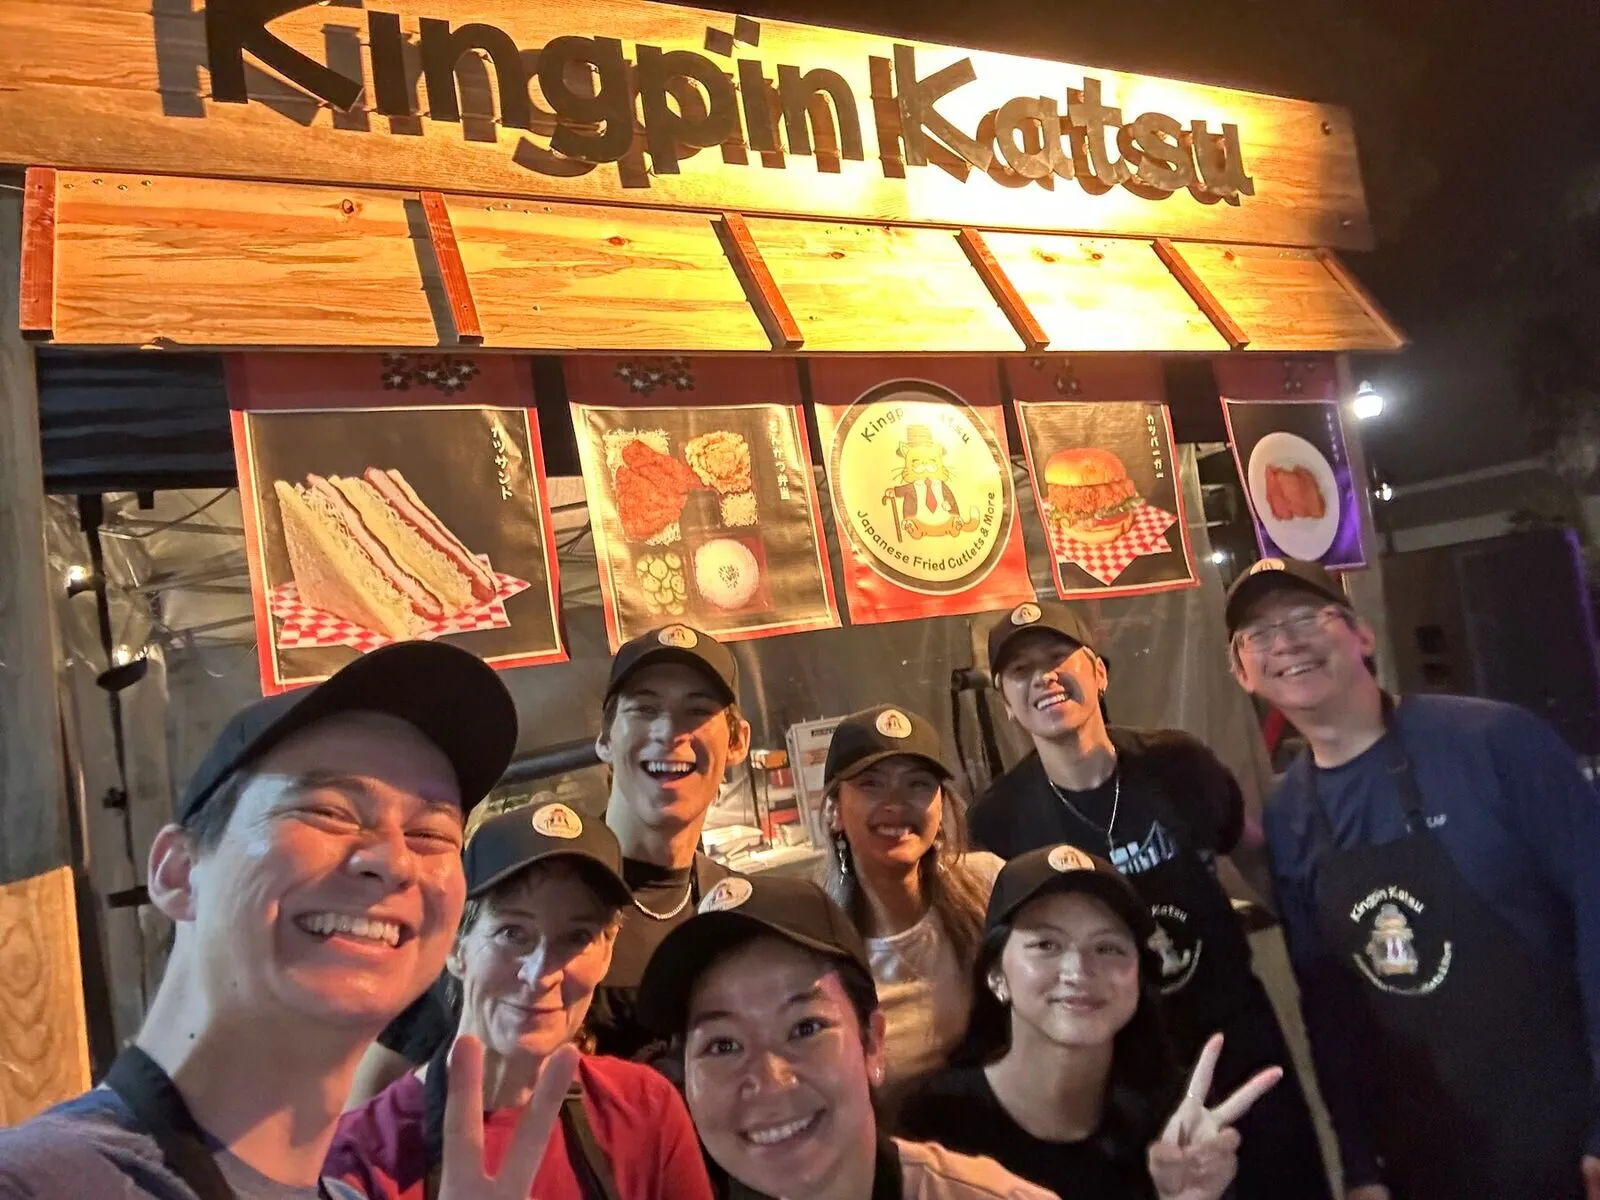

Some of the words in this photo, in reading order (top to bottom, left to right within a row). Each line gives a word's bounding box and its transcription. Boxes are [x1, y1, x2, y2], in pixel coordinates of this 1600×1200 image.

[206, 0, 864, 175] Kingpin
[894, 44, 1254, 197] Katsu
[860, 407, 904, 443] Kingp
[983, 492, 996, 527] More
[857, 509, 910, 564] Japanese
[980, 528, 989, 538] &
[913, 556, 946, 572] Fried
[947, 538, 985, 569] Cutlets
[1151, 904, 1188, 923] Katsu
